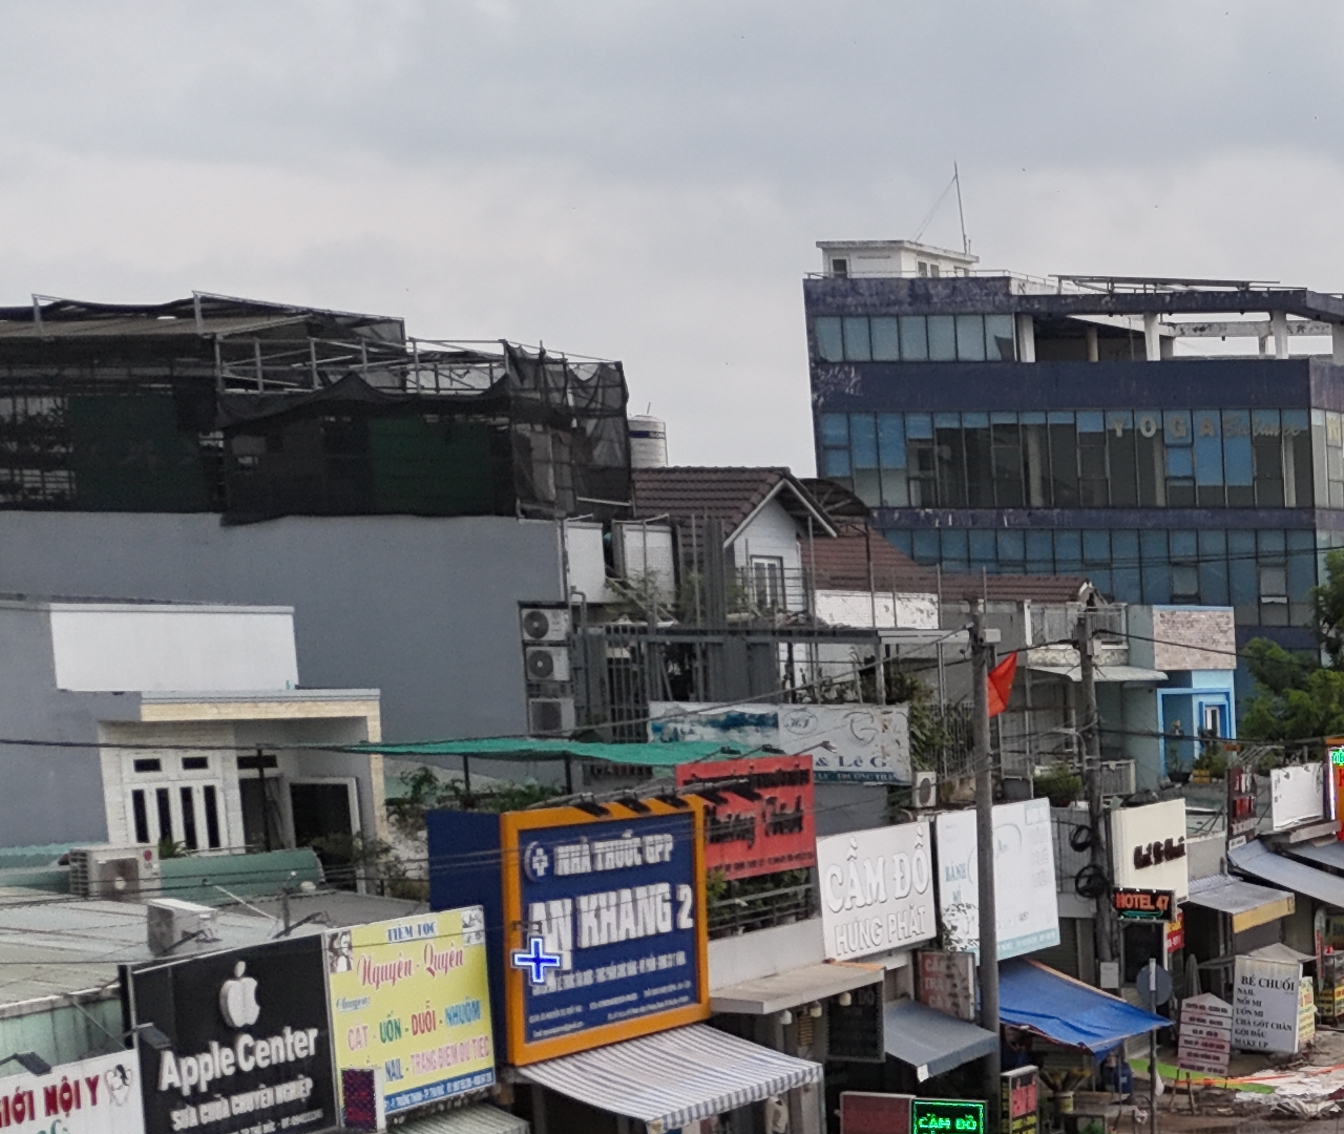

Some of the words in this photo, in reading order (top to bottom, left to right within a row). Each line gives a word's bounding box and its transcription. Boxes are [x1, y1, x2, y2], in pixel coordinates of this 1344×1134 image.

[1112, 415, 1215, 438] YOGA
[824, 838, 887, 914] CẦM
[893, 826, 930, 899] ĐỒ
[577, 883, 673, 948] KHANG
[676, 884, 693, 930] 2
[1115, 892, 1156, 910] HOTEL
[1156, 893, 1170, 910] 47
[1241, 974, 1256, 987] BÉ
[1258, 978, 1295, 991] CHUỐI
[158, 1040, 236, 1096] Apple
[237, 1025, 319, 1072] Center
[0, 1086, 35, 1128] IỚI
[43, 1076, 82, 1118] NỘI
[85, 1075, 99, 1106] Y
